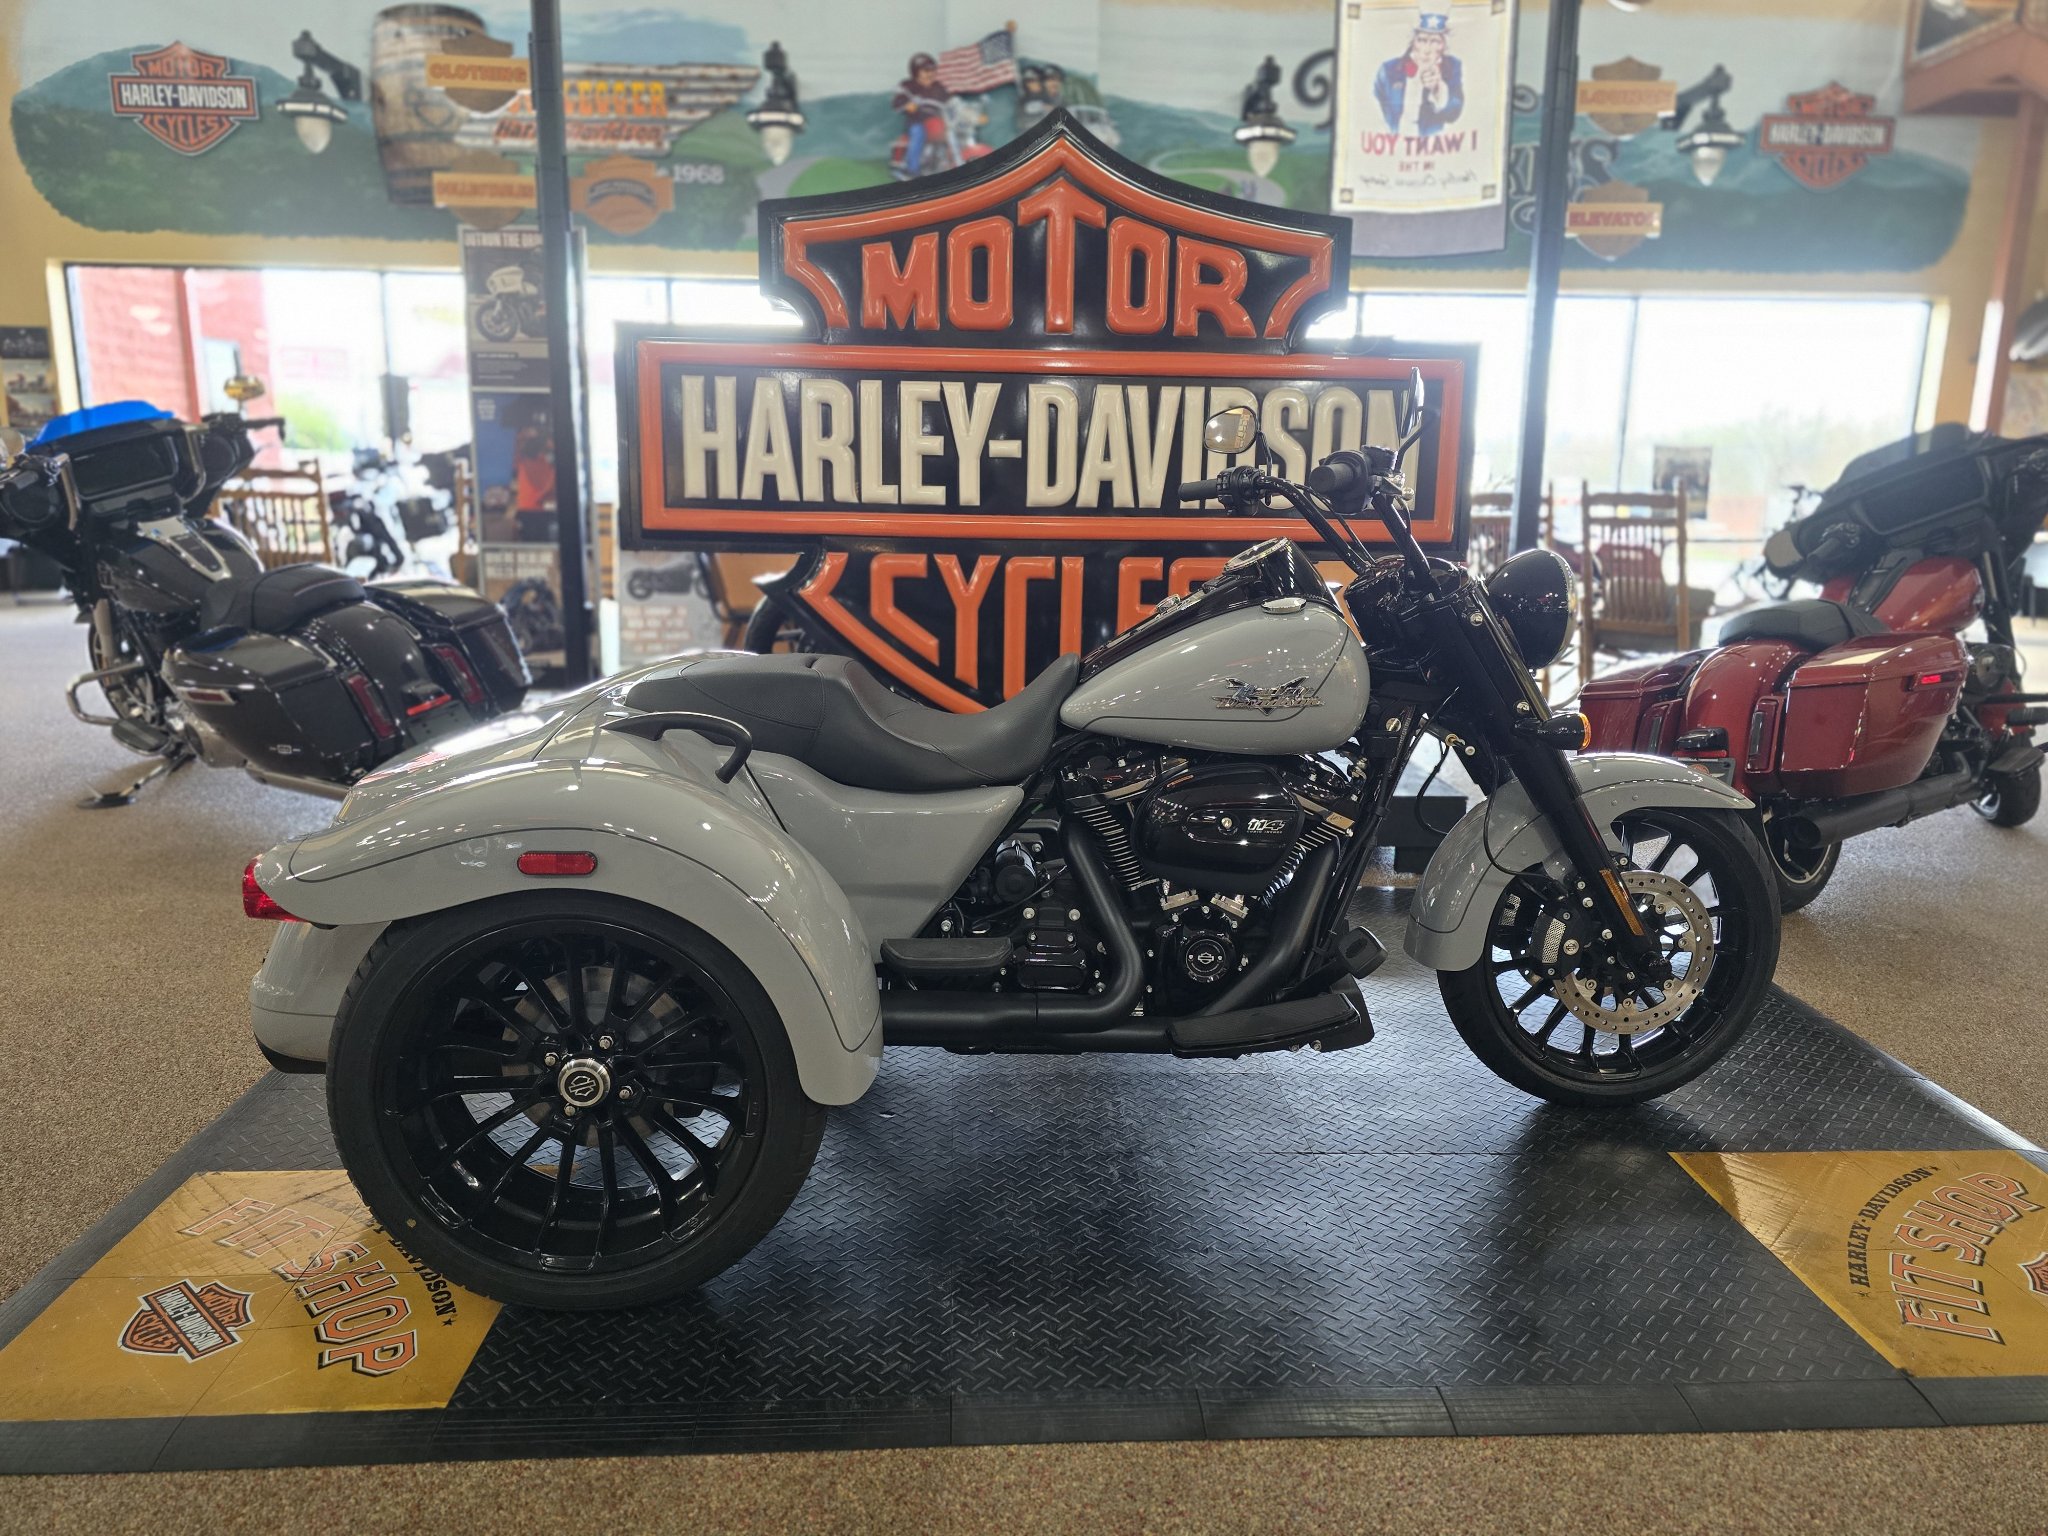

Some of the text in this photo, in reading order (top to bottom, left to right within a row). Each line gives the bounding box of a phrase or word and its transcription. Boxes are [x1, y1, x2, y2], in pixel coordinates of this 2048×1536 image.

[148, 54, 215, 78] MOTOR
[429, 63, 527, 83] CLOTHING
[121, 83, 248, 109] HARLEY-DAVIDSON
[153, 114, 220, 145] CYCLES
[673, 165, 724, 184] 1968
[861, 176, 1257, 339] MOTOR
[1247, 818, 1287, 831] 114
[1889, 1172, 2046, 1345] FIT SHOP
[178, 1197, 419, 1377] FIT SHOP
[154, 1288, 224, 1351] HARLEY-DAVIDSON
